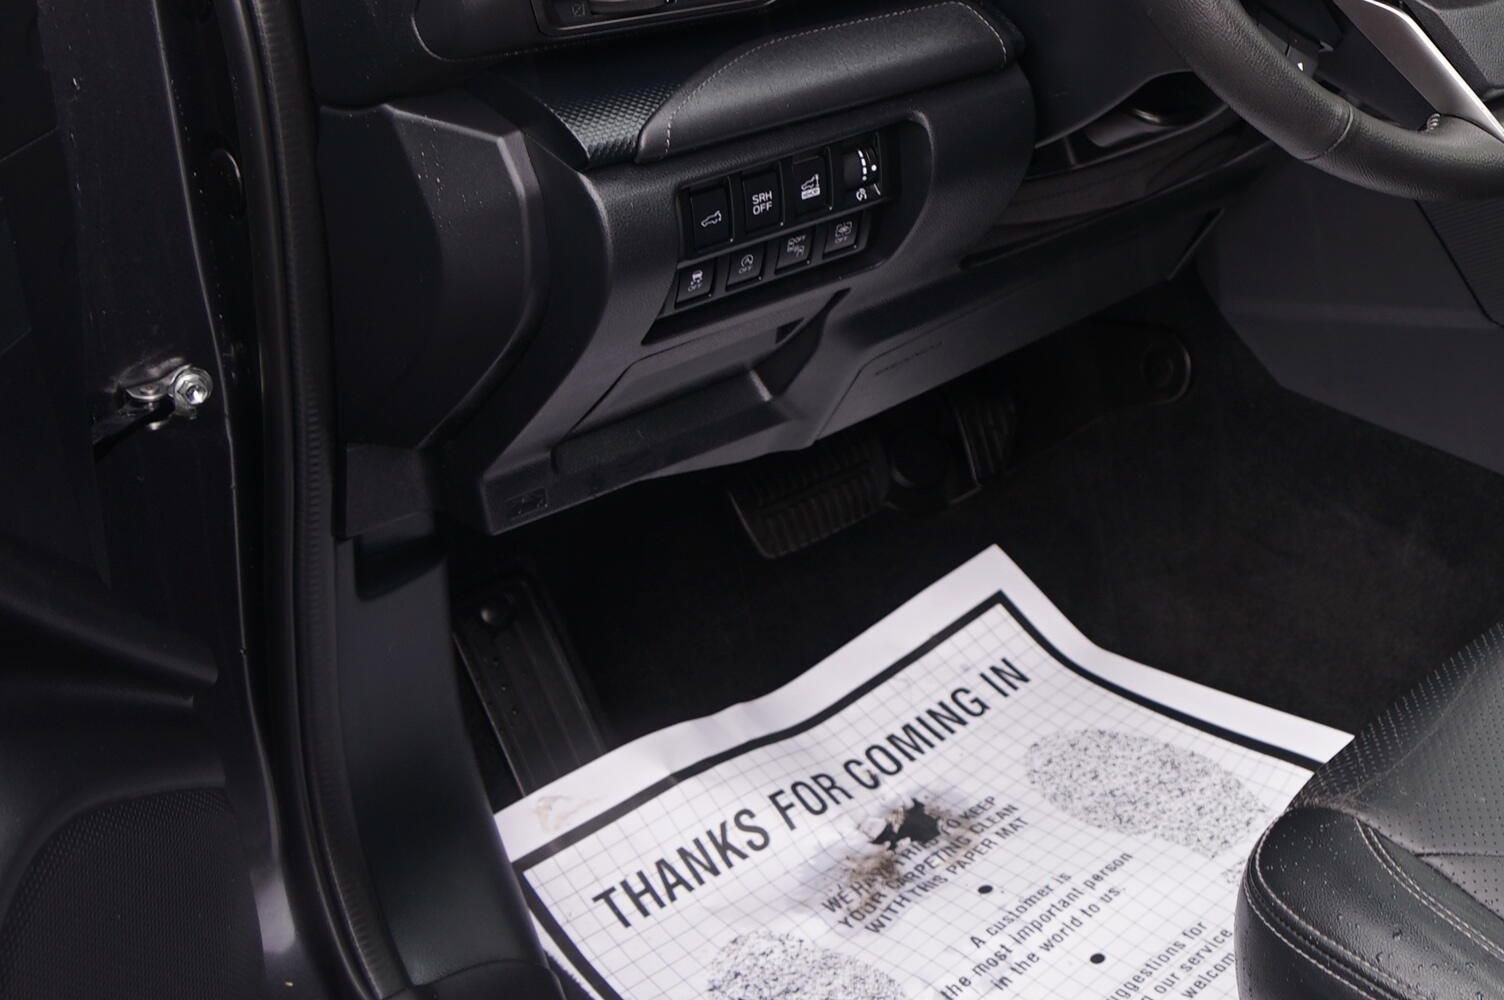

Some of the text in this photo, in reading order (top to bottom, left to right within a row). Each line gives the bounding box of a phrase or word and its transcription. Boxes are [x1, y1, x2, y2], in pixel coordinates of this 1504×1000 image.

[752, 190, 773, 205] SRH
[752, 201, 773, 216] OFF
[592, 657, 1030, 928] THANKS FOR COMING IN
[959, 795, 995, 821] KEEP
[838, 804, 1019, 929] YOUR CARPETING CLEAN
[865, 816, 1029, 934] WITH THIS PAPER MAT
[939, 851, 1134, 1000] the most important person
[970, 871, 1073, 950] A customer is
[991, 974, 1014, 991] in
[1010, 951, 1041, 976] the
[1039, 915, 1084, 954] world
[1079, 902, 1101, 919] to
[1181, 921, 1208, 940] for
[1153, 927, 1233, 994] our service
[1181, 951, 1235, 1000] welcom
